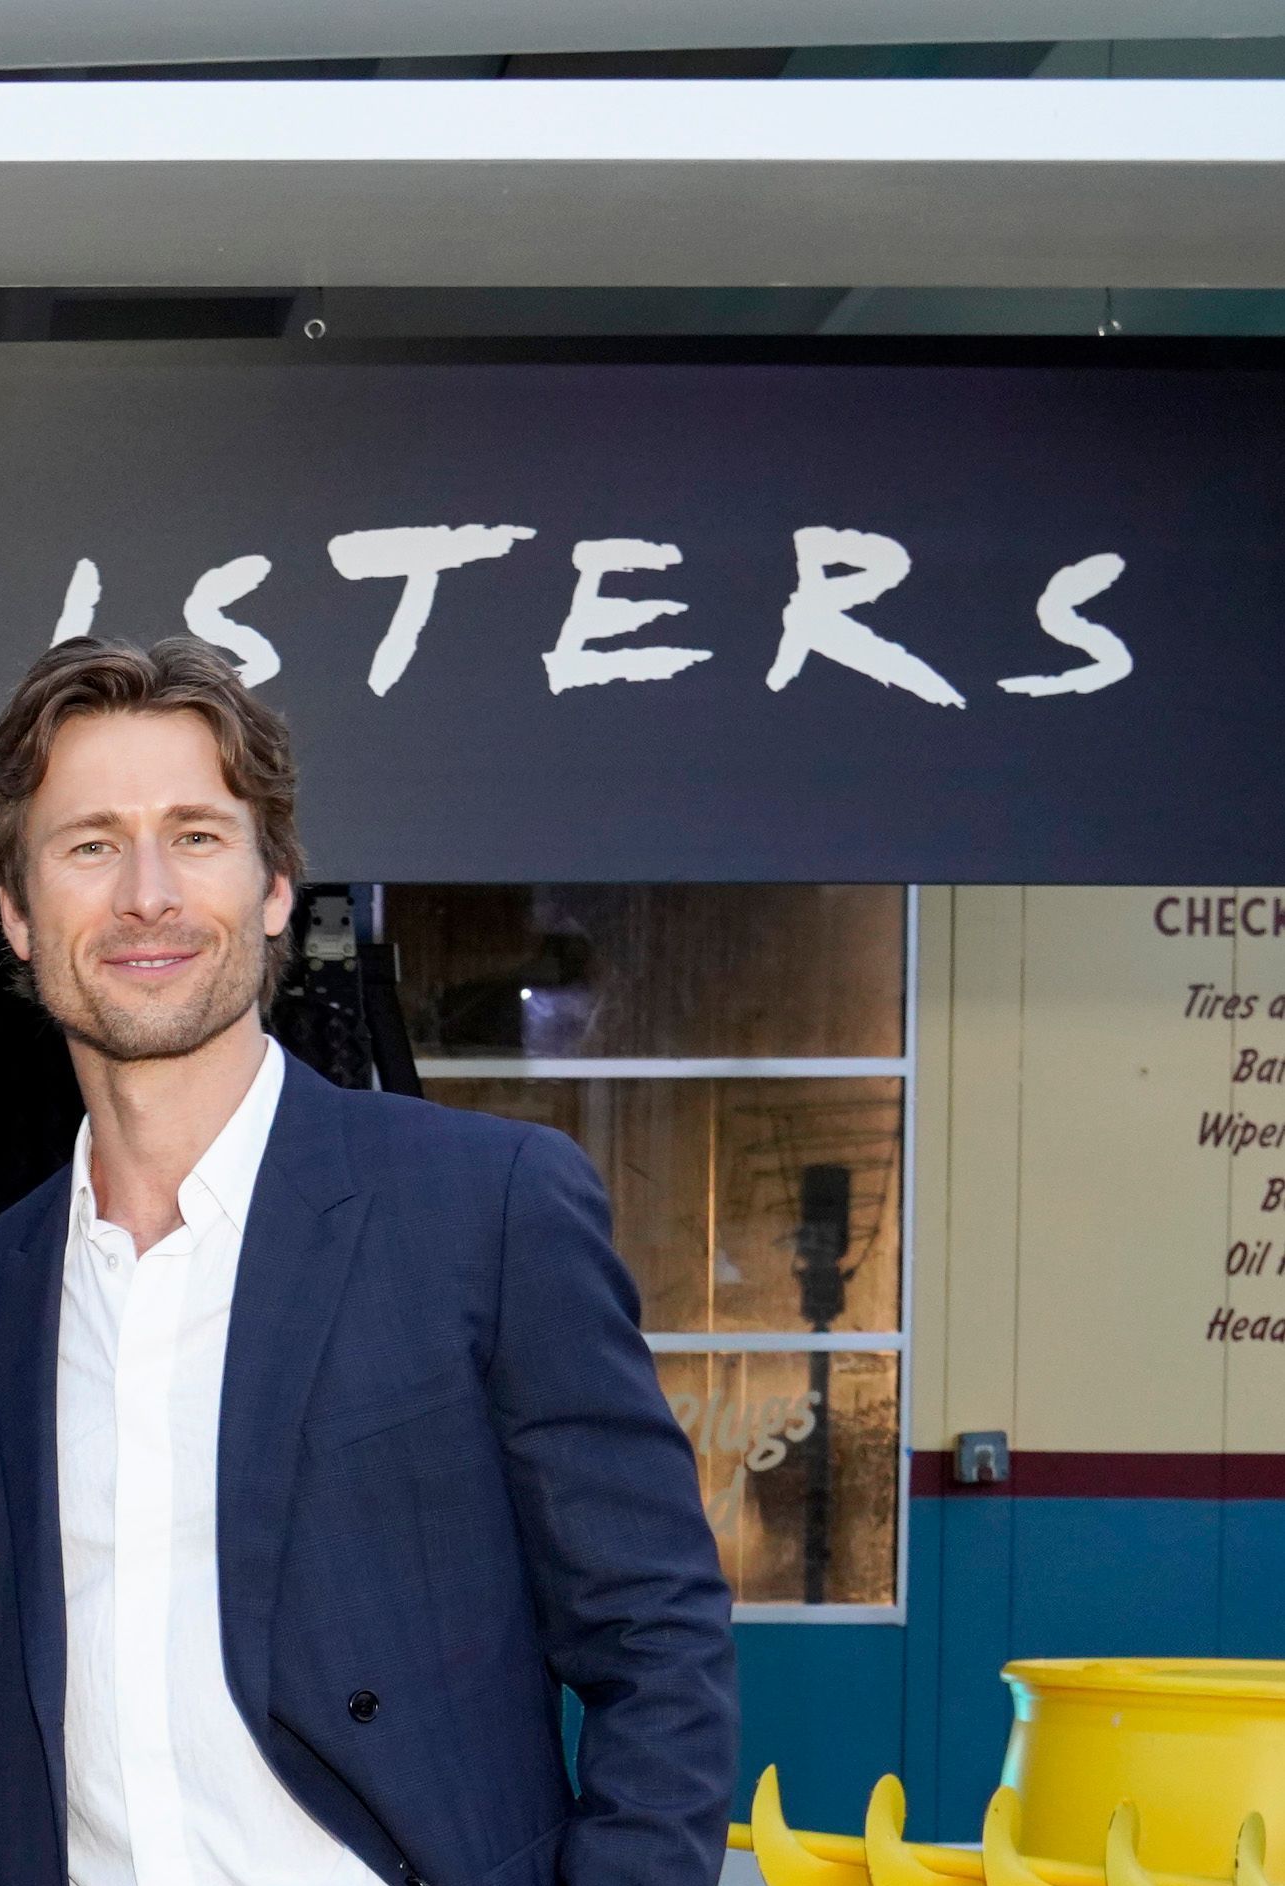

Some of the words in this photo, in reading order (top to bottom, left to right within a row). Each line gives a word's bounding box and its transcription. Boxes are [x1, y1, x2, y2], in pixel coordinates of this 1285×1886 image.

[1184, 982, 1259, 1020] Tires
[1261, 1176, 1285, 1212] B
[1226, 1240, 1272, 1276] Oil
